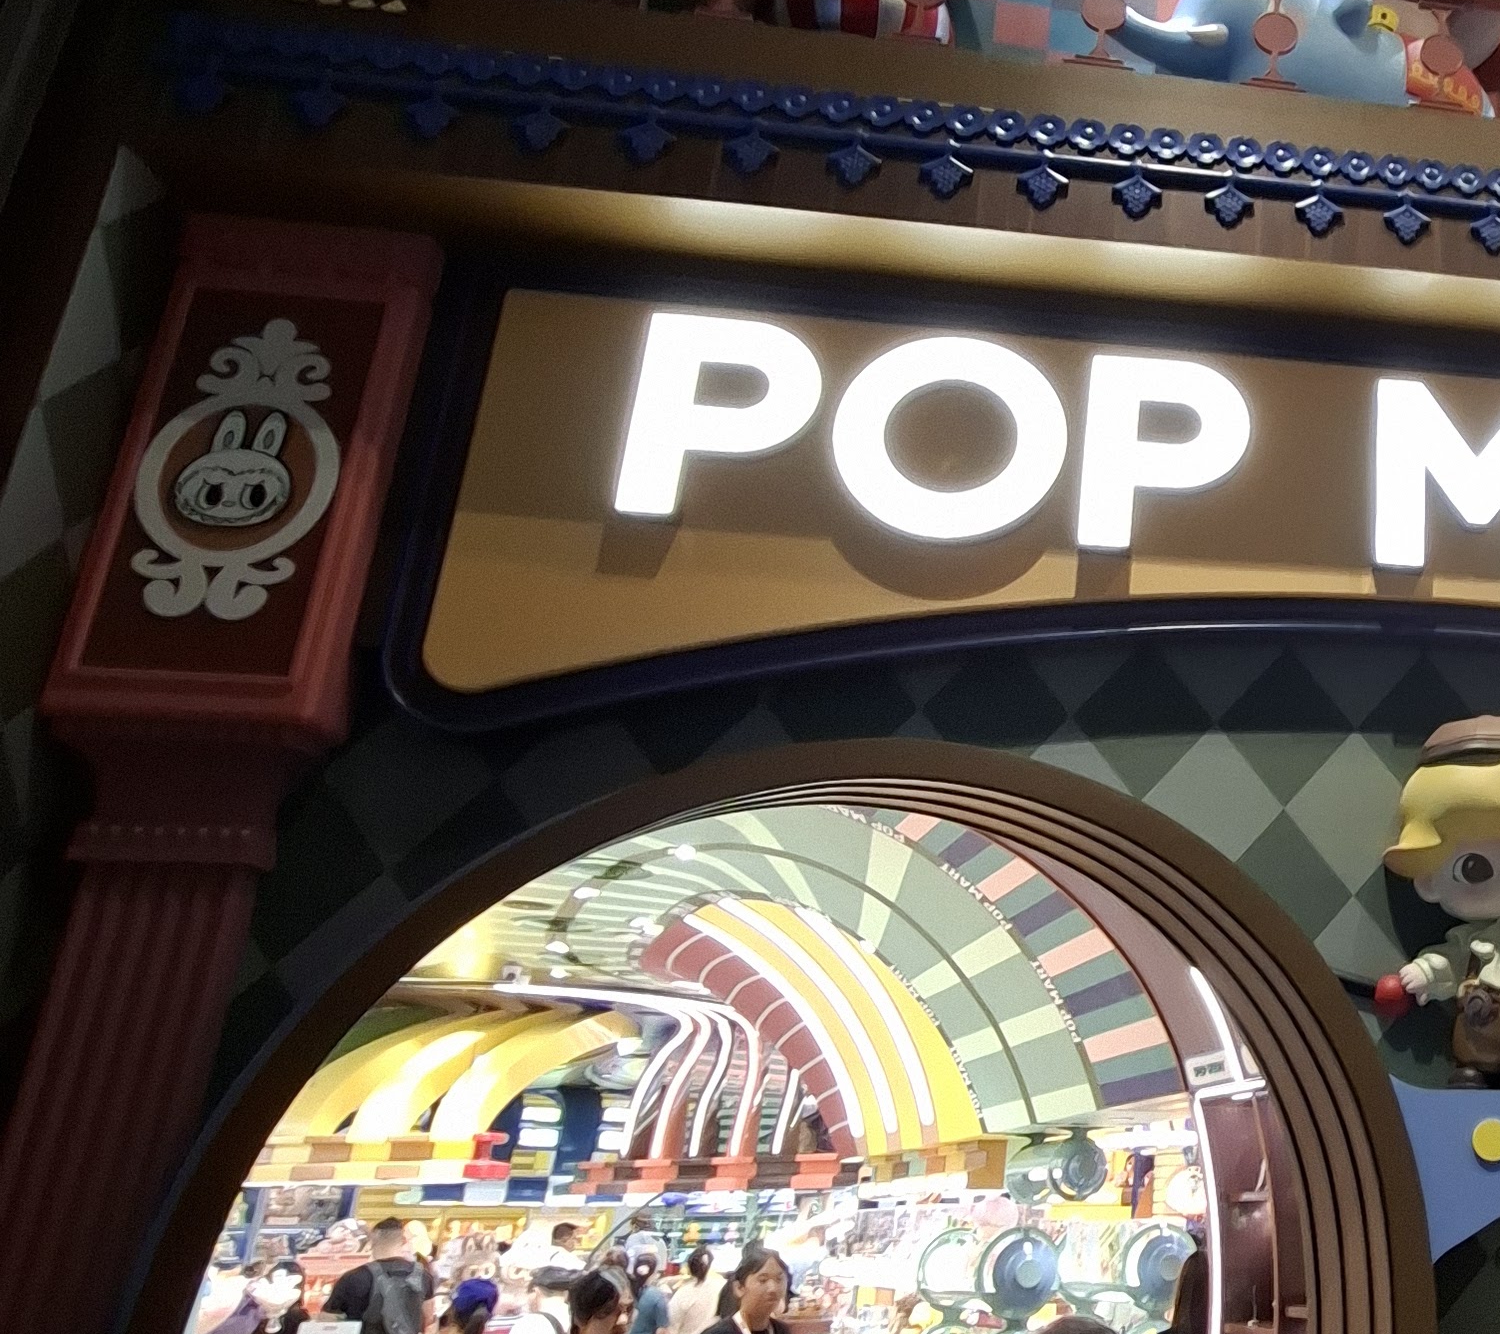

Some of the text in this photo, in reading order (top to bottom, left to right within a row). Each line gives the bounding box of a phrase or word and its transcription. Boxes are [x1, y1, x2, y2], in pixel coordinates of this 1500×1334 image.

[613, 311, 1252, 553] POP
[941, 863, 1013, 930] POP MART
[1030, 960, 1081, 1043] POP MART
